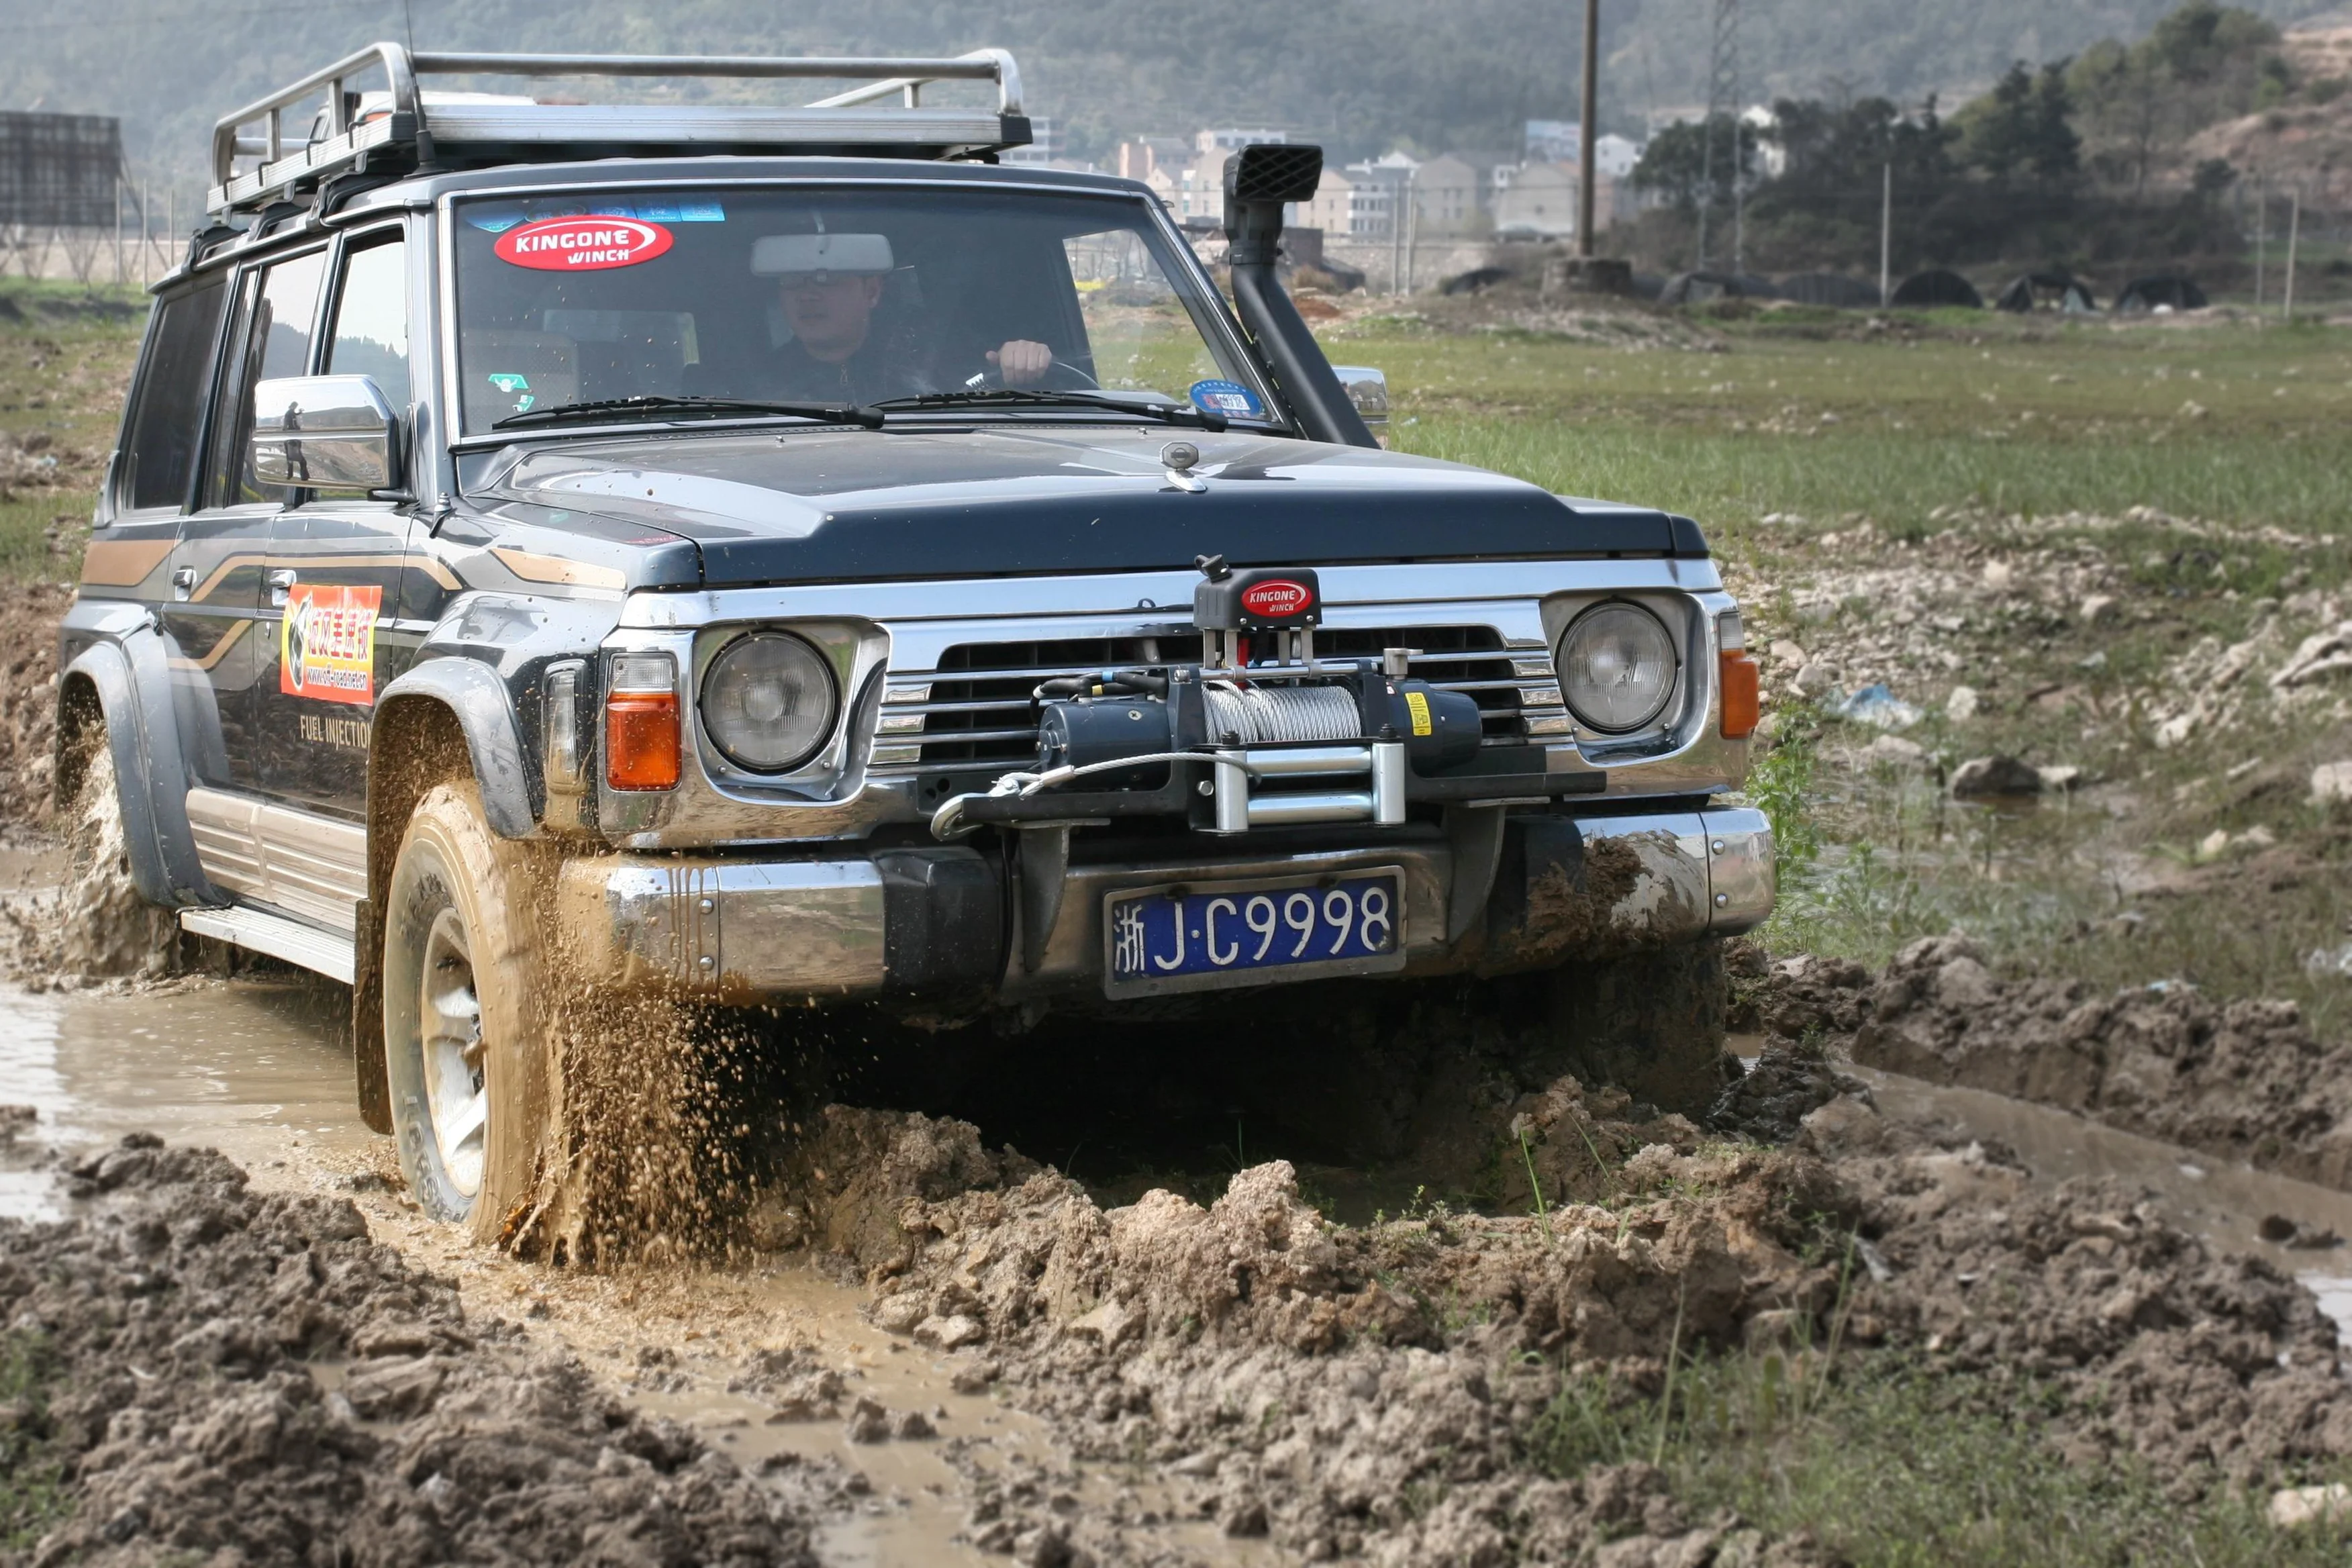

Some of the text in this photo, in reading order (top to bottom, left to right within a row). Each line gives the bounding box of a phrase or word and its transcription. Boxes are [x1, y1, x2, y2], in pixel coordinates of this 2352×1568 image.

[516, 230, 629, 253] KINGONE
[567, 249, 629, 264] WINCH
[1250, 590, 1295, 603] KINGONE
[1269, 604, 1294, 612] WINCH
[300, 715, 324, 742] FUEL
